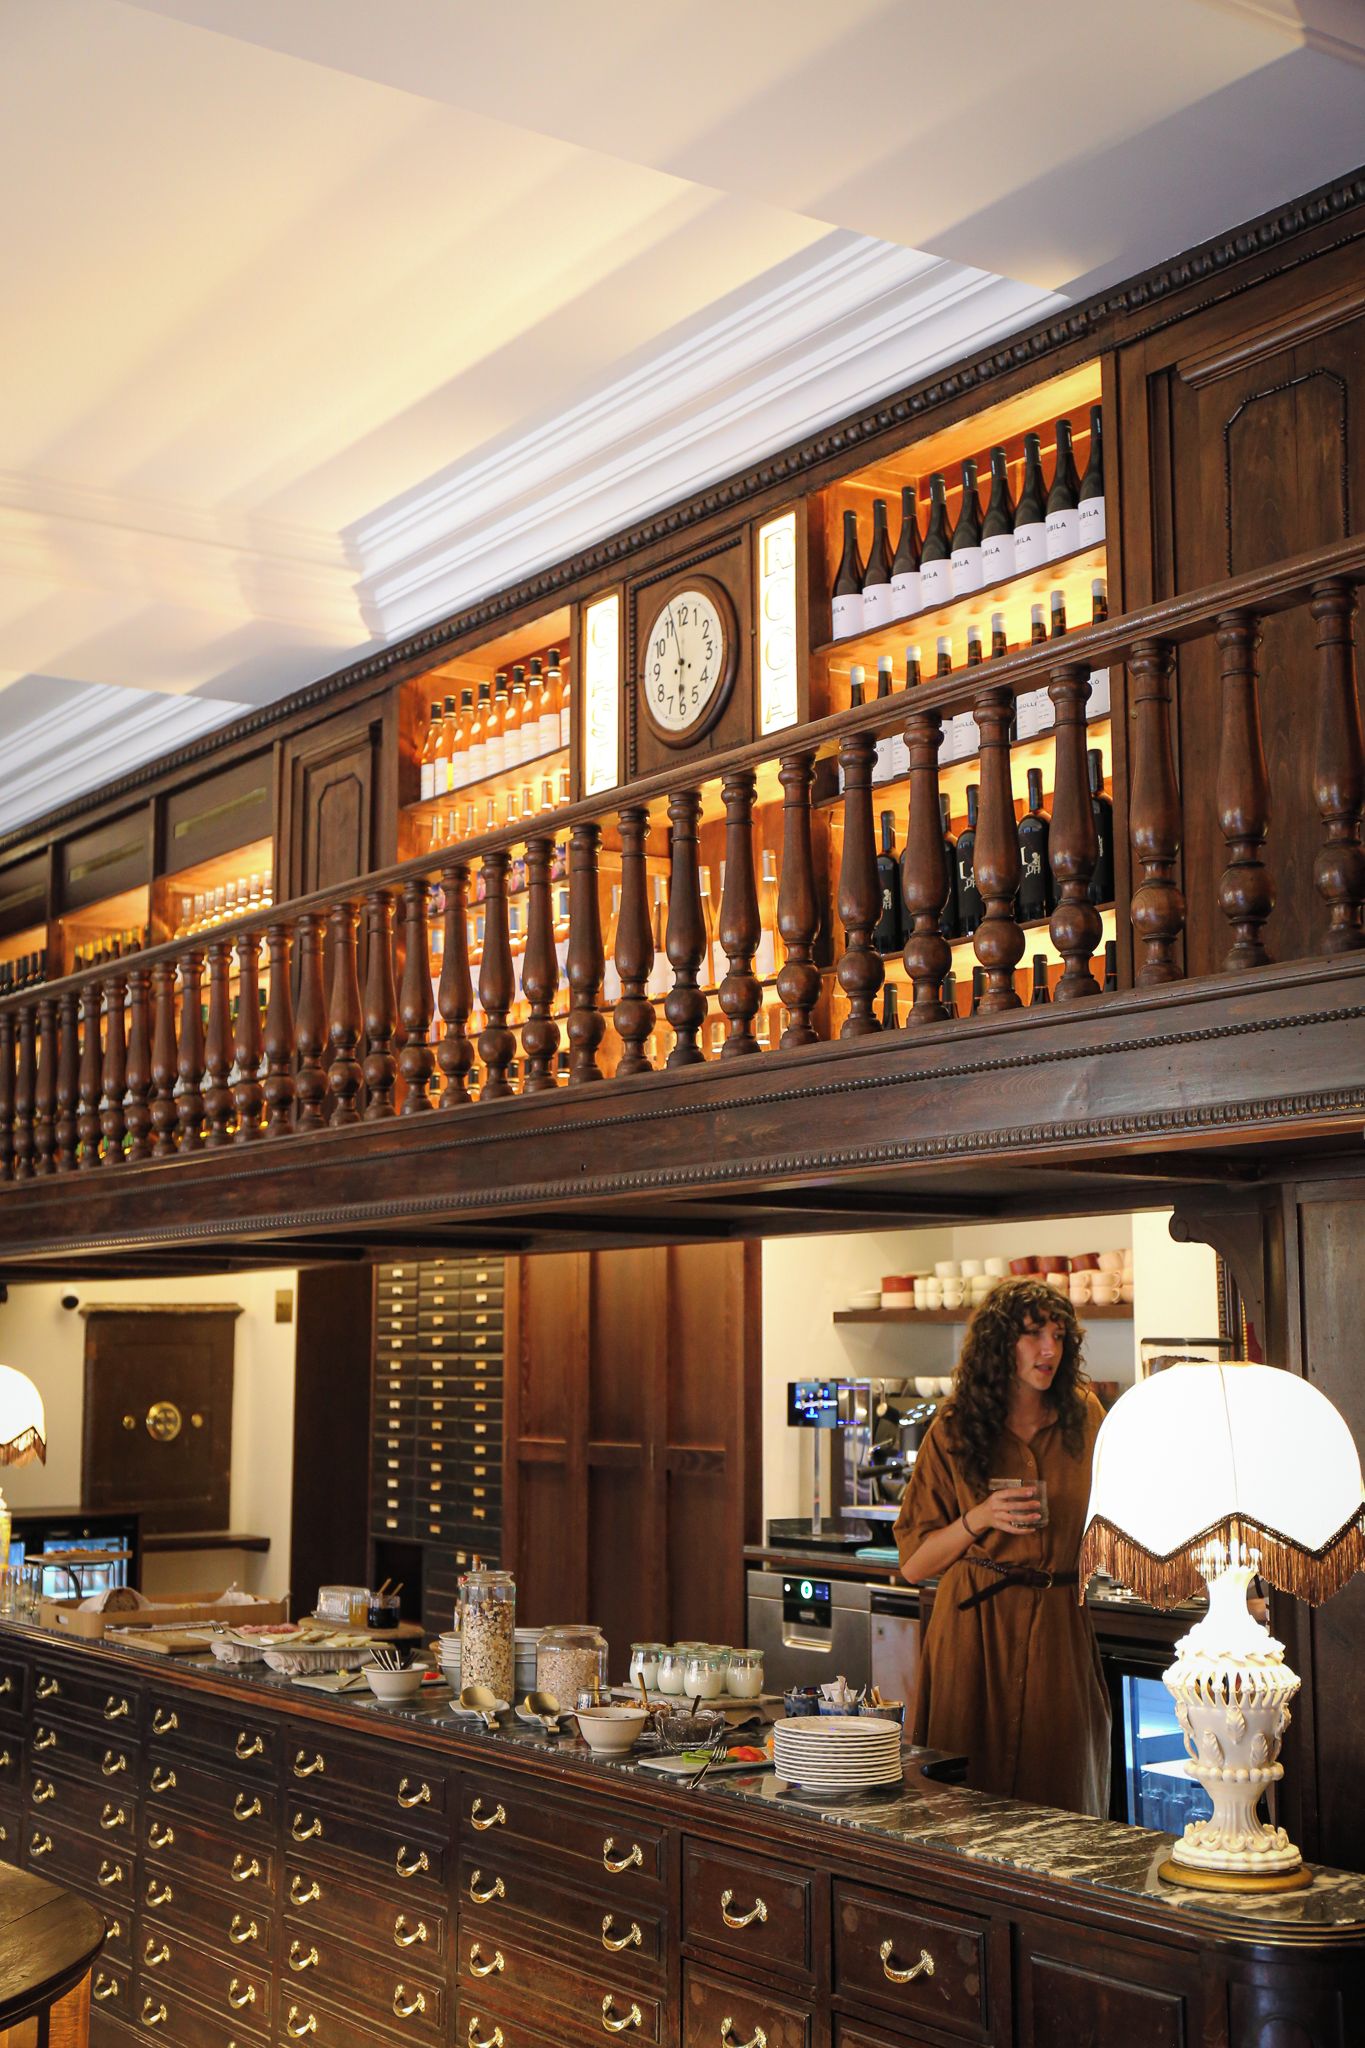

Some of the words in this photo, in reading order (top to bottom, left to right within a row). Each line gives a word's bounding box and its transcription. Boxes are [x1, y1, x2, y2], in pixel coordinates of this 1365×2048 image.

[677, 606, 688, 627] 12
[693, 608, 698, 626] 1
[665, 619, 674, 638] 11
[702, 619, 710, 639] 2
[656, 638, 666, 659] 10
[705, 640, 713, 660] 3
[653, 663, 661, 682] 9
[700, 666, 709, 683] 4
[657, 684, 665, 703] 8
[691, 685, 699, 704] 5
[667, 696, 674, 715] 7
[679, 696, 687, 716] 6
